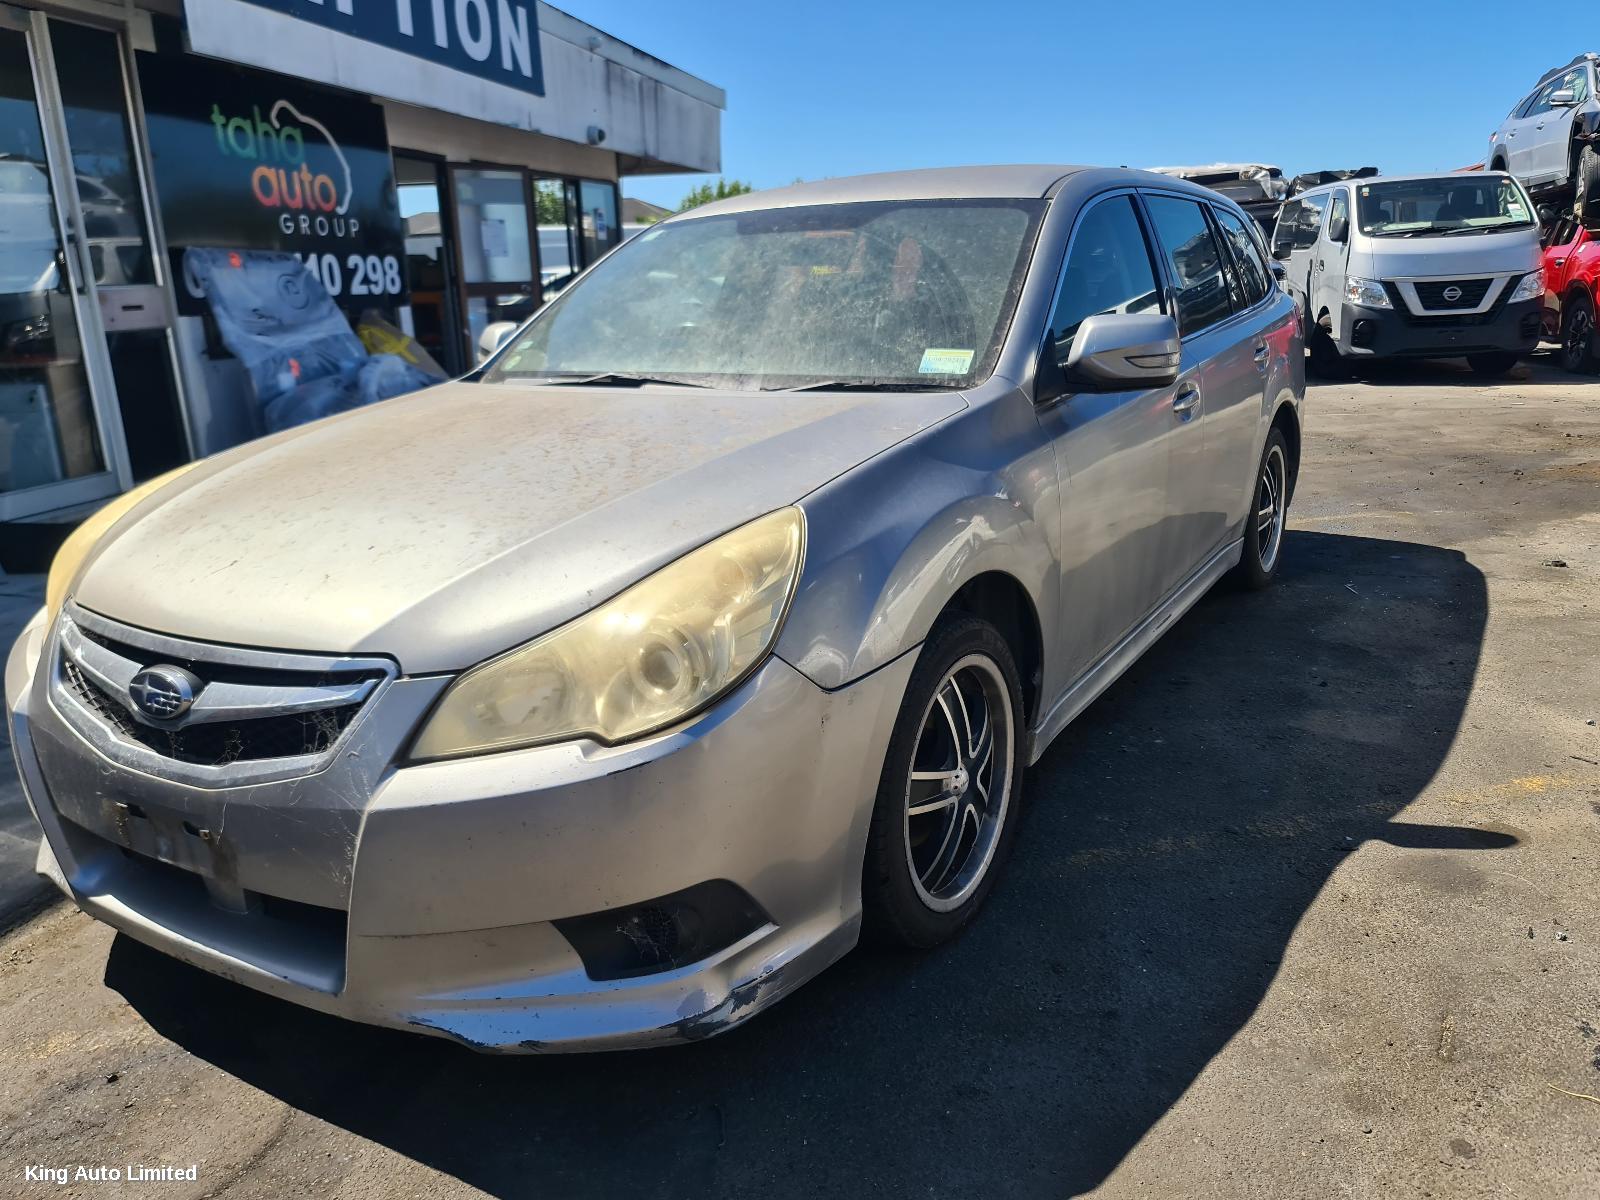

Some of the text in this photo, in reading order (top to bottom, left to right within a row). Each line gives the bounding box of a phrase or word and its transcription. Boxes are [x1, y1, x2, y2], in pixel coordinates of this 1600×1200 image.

[211, 103, 305, 164] taha
[252, 162, 337, 213] auto
[279, 213, 360, 239] GROUP
[294, 252, 402, 297] 10 298
